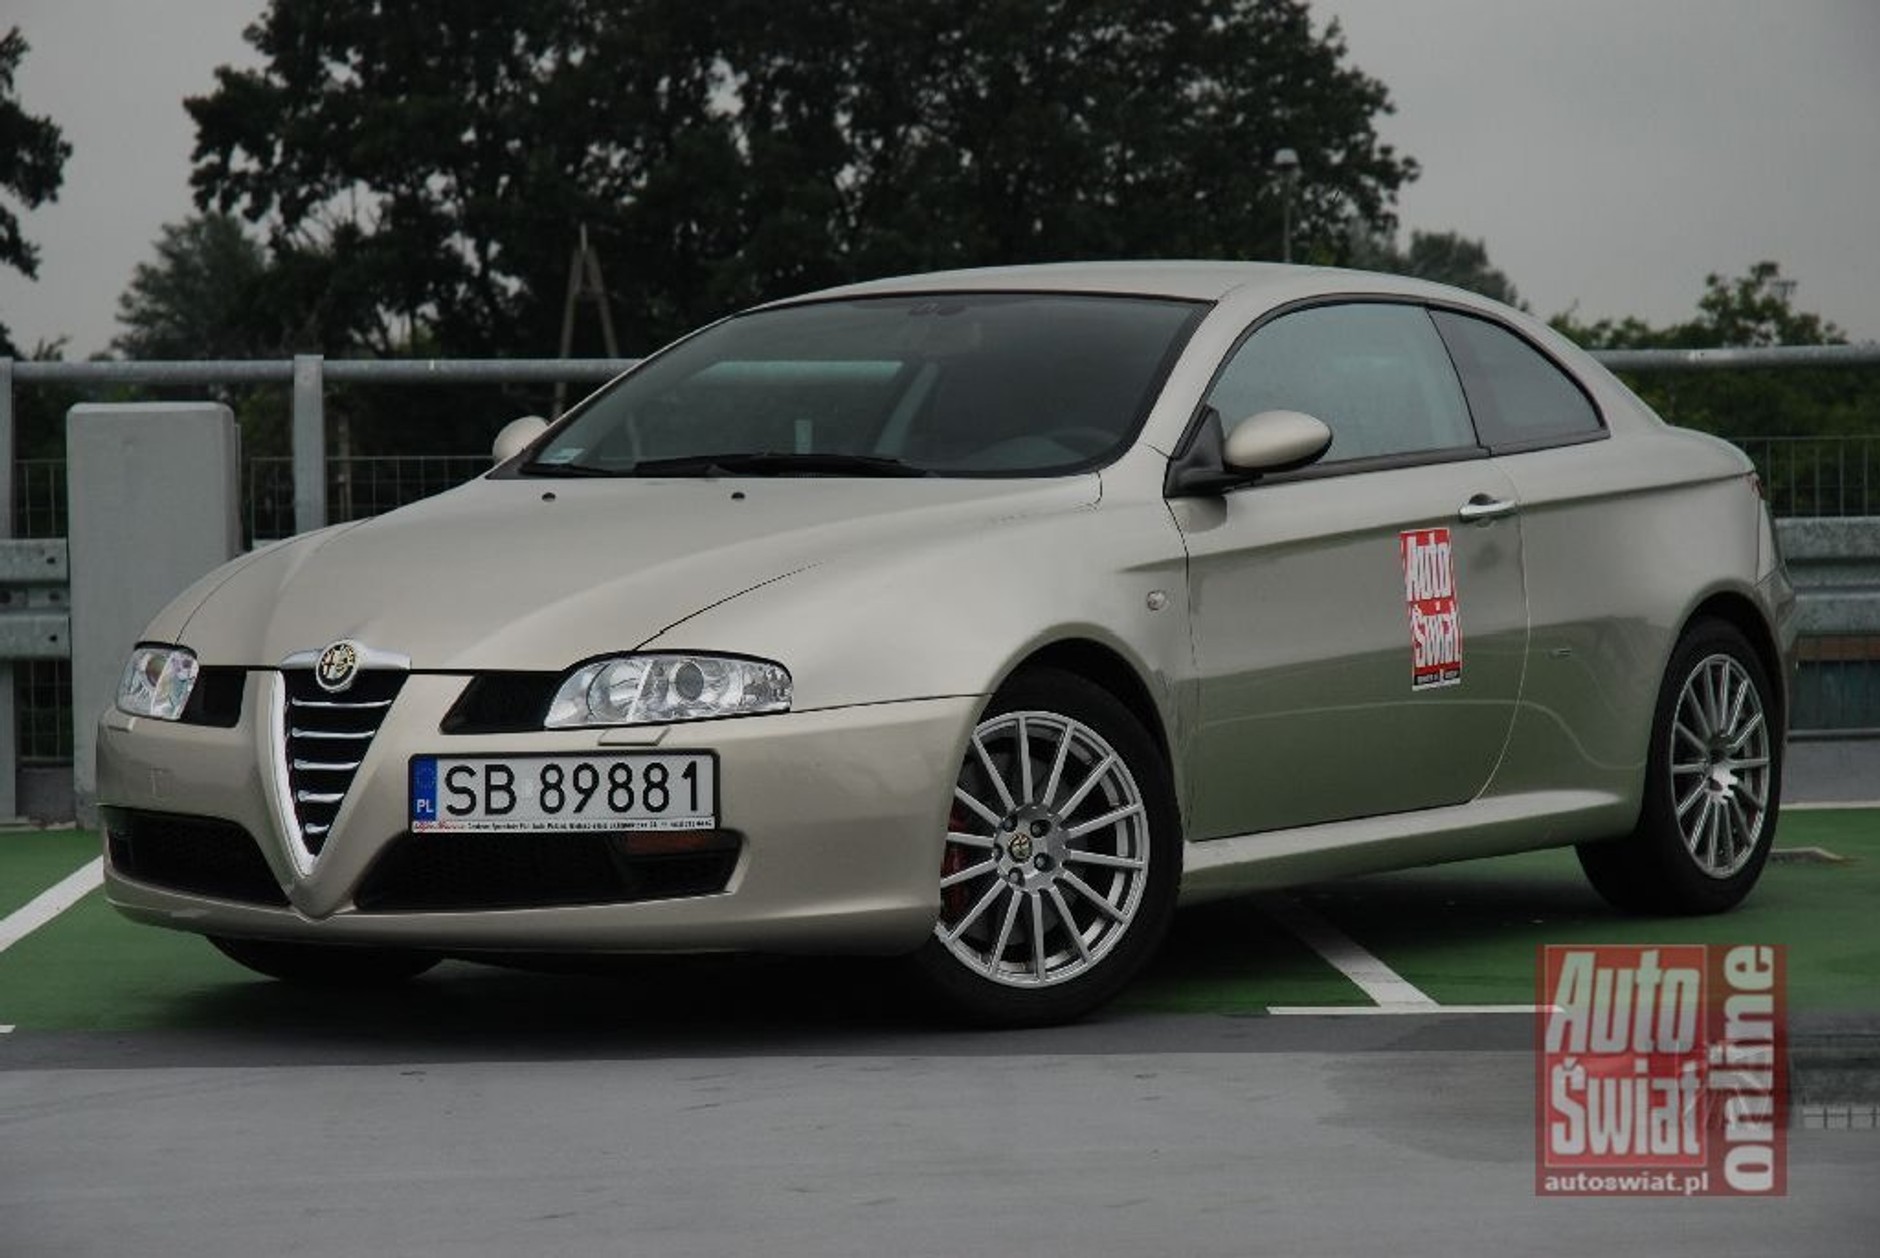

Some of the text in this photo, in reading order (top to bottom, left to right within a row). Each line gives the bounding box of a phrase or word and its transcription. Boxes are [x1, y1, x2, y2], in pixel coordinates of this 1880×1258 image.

[1406, 532, 1451, 602] Auto
[416, 799, 434, 813] PL
[445, 760, 698, 816] SB 89881
